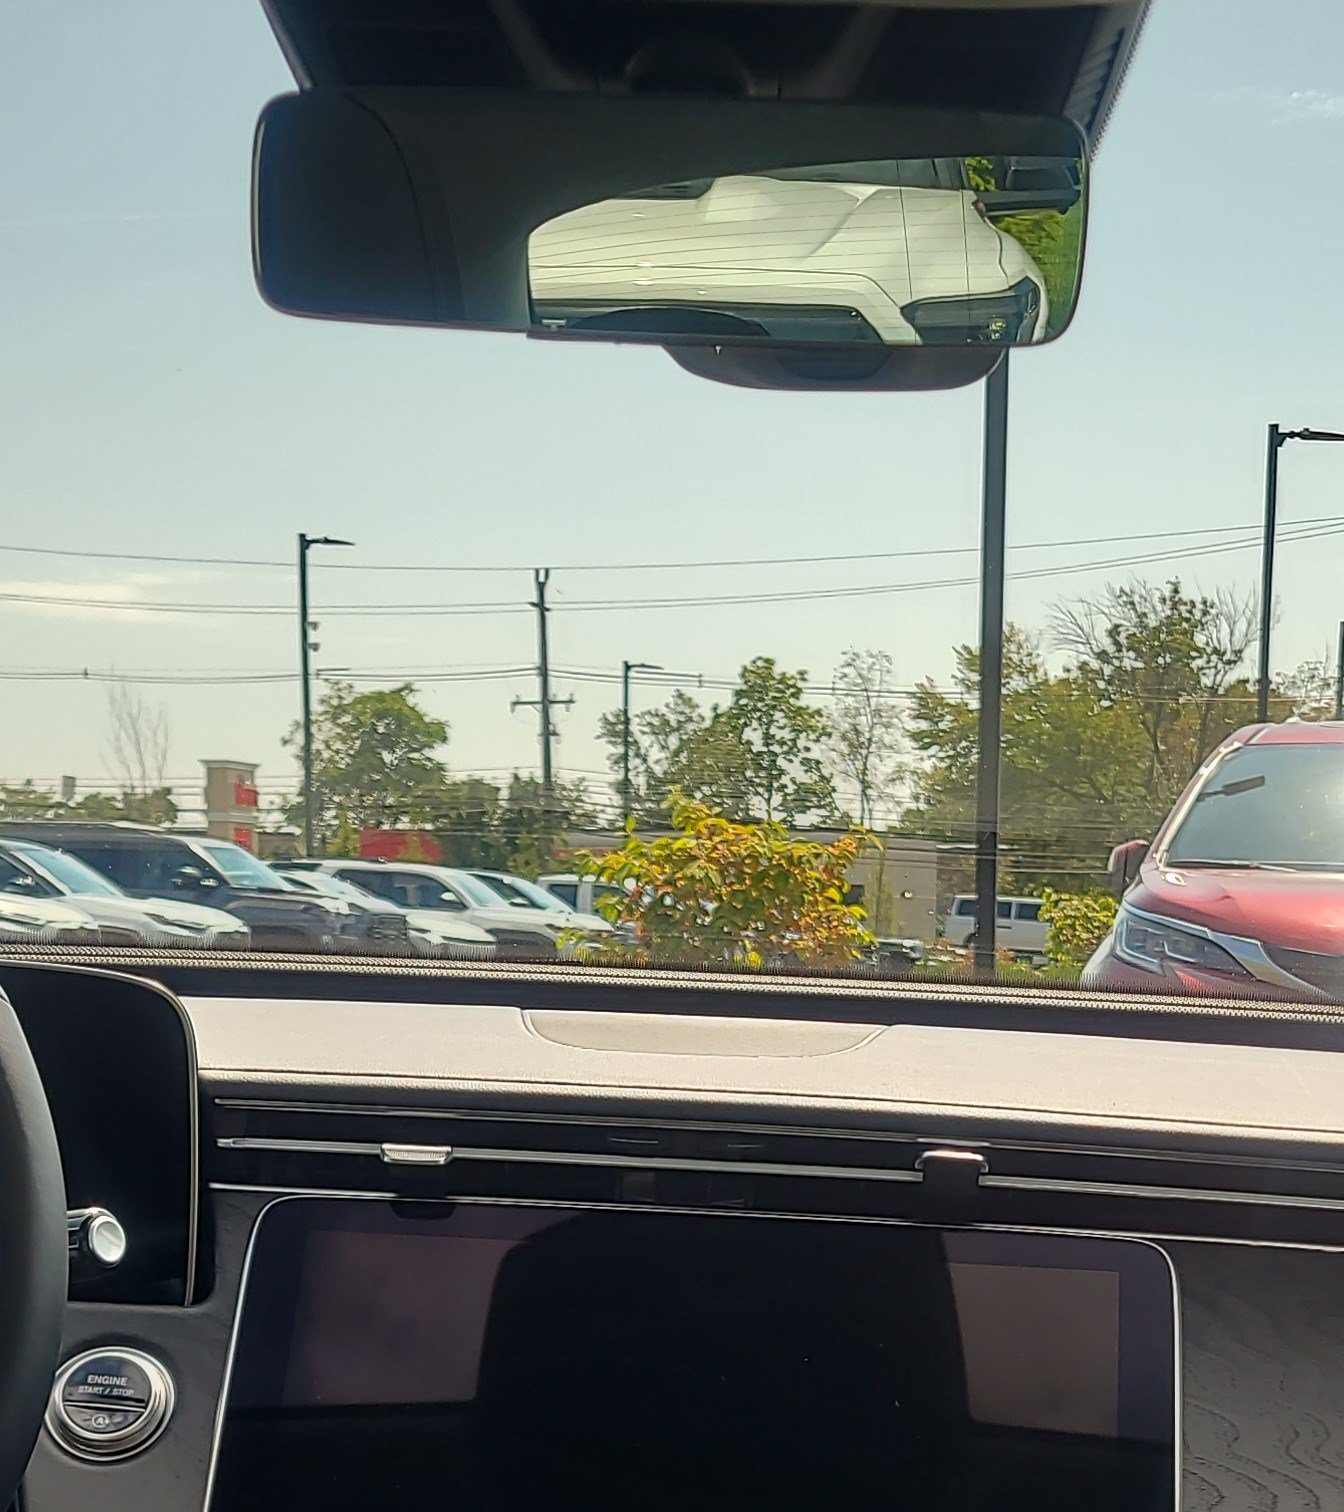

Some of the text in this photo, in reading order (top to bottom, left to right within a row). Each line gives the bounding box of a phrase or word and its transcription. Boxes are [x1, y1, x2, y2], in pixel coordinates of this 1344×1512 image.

[87, 1374, 128, 1386] ENGINE
[78, 1385, 104, 1394] START
[112, 1388, 135, 1396] STOP
